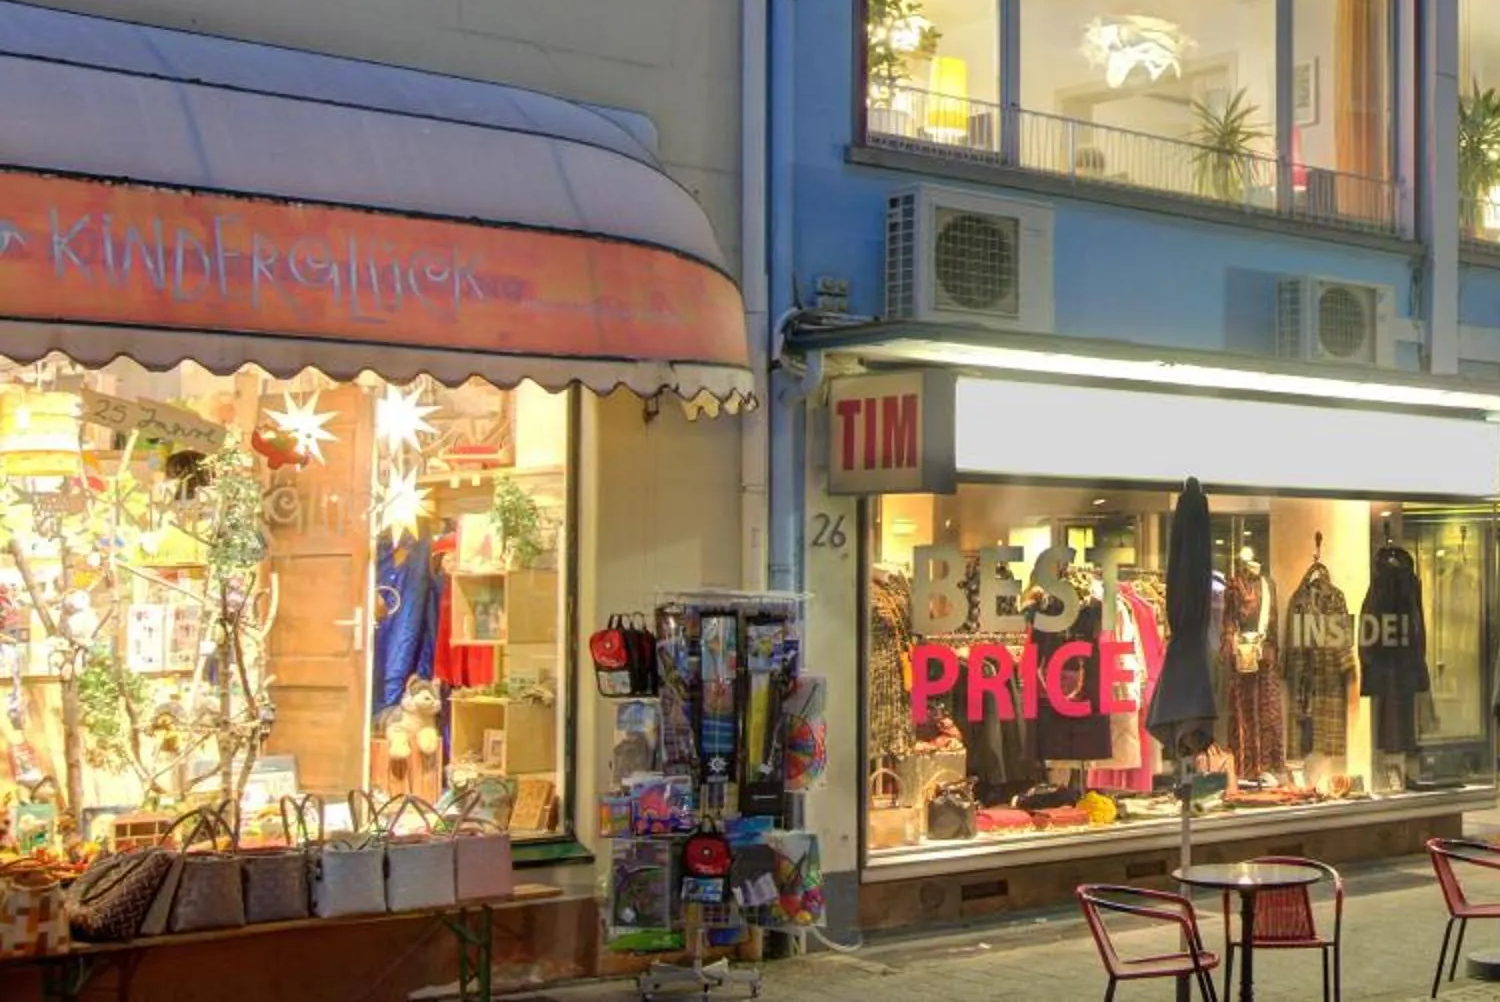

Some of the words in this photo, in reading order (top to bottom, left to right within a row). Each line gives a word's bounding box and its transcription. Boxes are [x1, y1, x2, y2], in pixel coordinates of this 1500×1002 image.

[836, 394, 918, 471] TIM
[812, 512, 848, 548] 26
[911, 545, 1138, 634] BEST
[1292, 612, 1411, 648] INSIDE!
[911, 640, 1138, 724] PRICE
